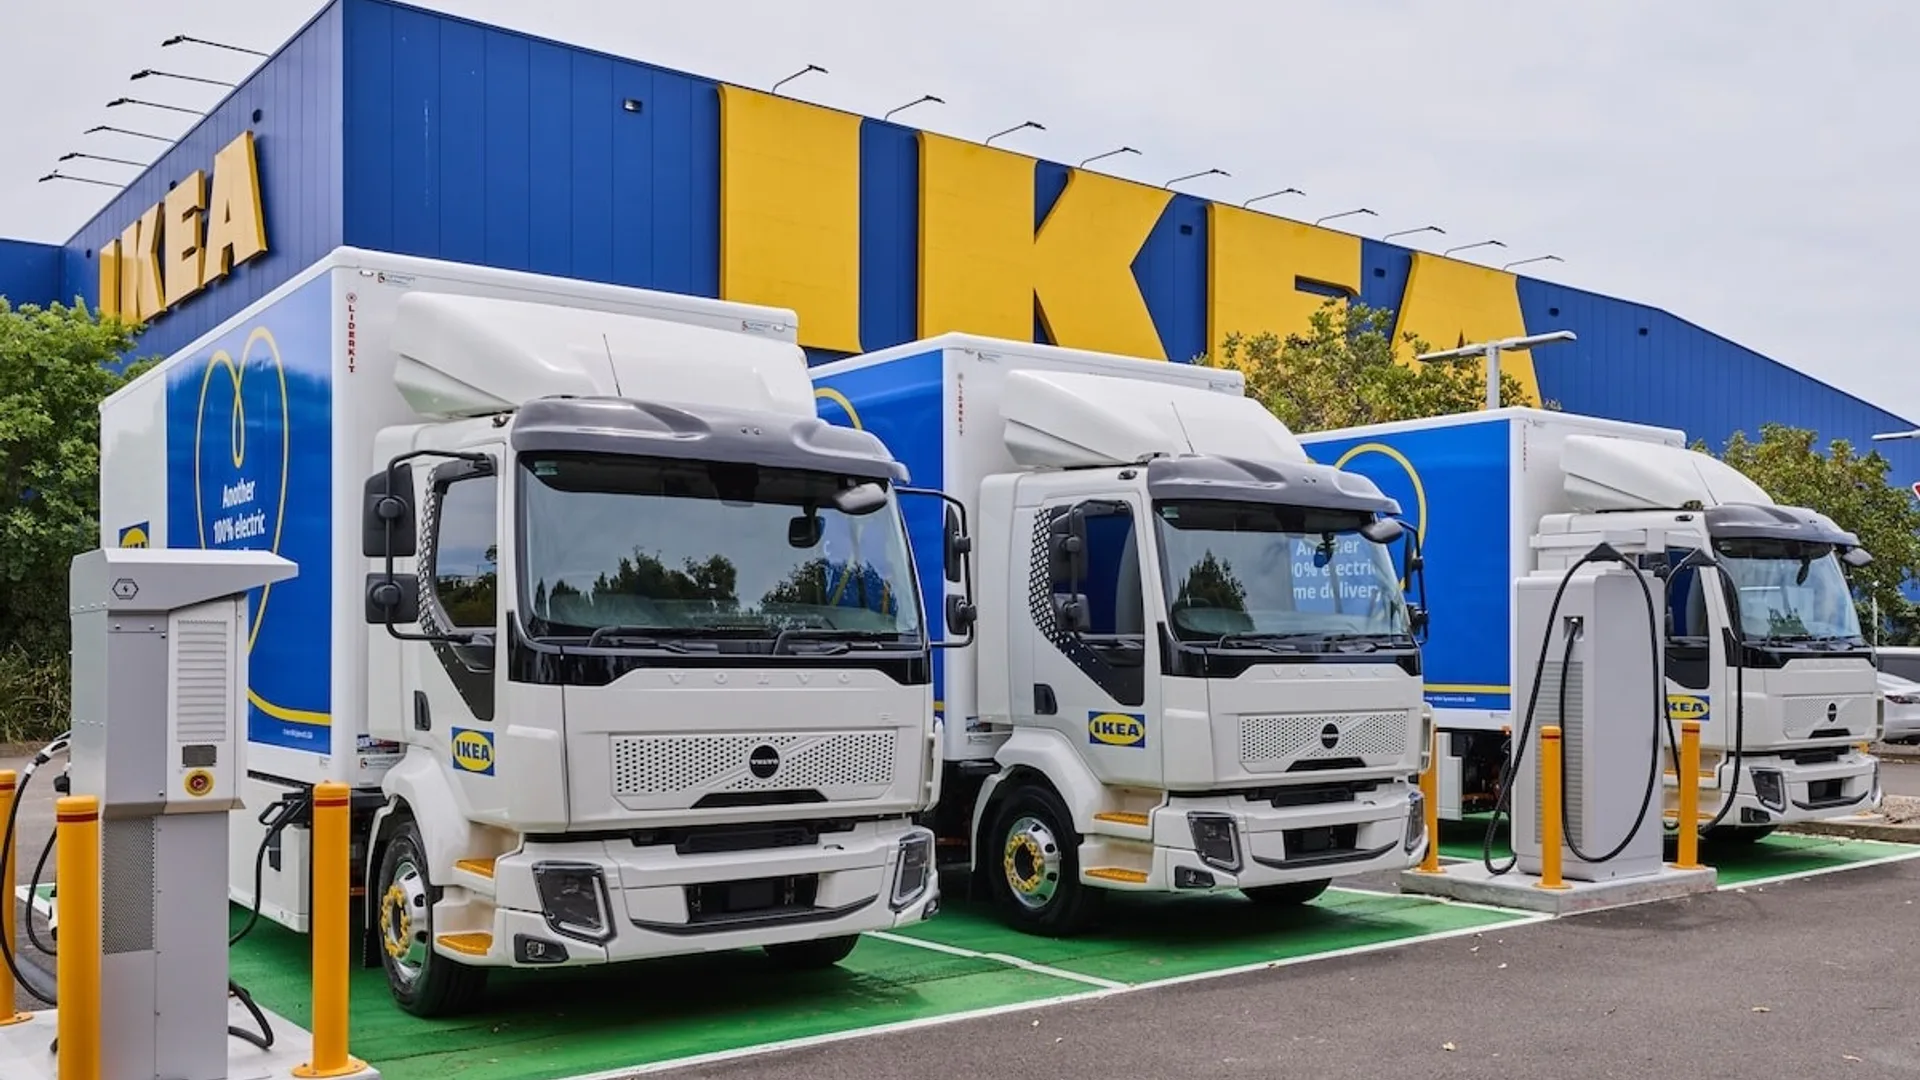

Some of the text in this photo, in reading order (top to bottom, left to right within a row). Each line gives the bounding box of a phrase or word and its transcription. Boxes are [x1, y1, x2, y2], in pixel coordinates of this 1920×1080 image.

[99, 129, 268, 326] IKEA
[717, 84, 1542, 408] IKEA
[348, 304, 356, 373] LIDERKIT
[222, 477, 255, 509] Another
[213, 507, 265, 544] 100% electric
[667, 671, 852, 685] VOLVO
[1667, 702, 1704, 712] KEA
[1094, 720, 1140, 736] IKEA
[456, 739, 490, 761] IKEA
